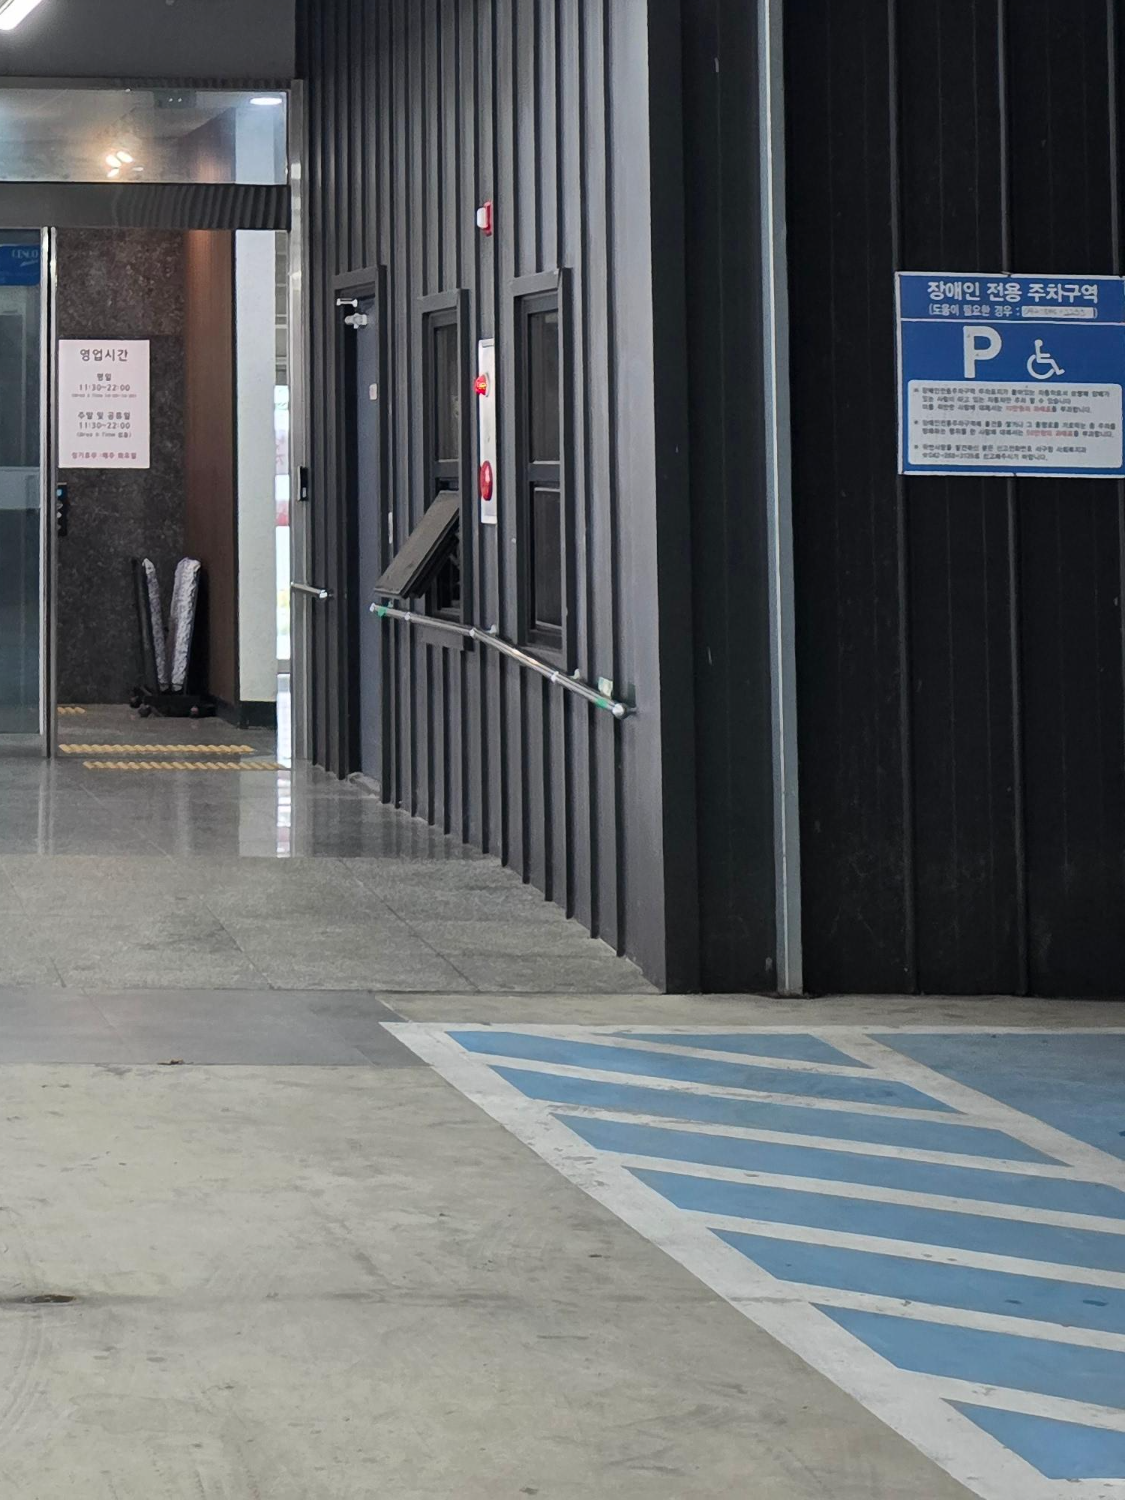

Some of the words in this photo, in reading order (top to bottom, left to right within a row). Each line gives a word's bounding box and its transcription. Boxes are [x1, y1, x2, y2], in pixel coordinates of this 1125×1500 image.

[927, 281, 981, 301] 장애인
[987, 282, 1023, 303] 전용
[1027, 283, 1099, 304] 주차구역
[994, 305, 1013, 318] 경우
[79, 348, 128, 362] 영업시간
[963, 325, 1002, 379] P
